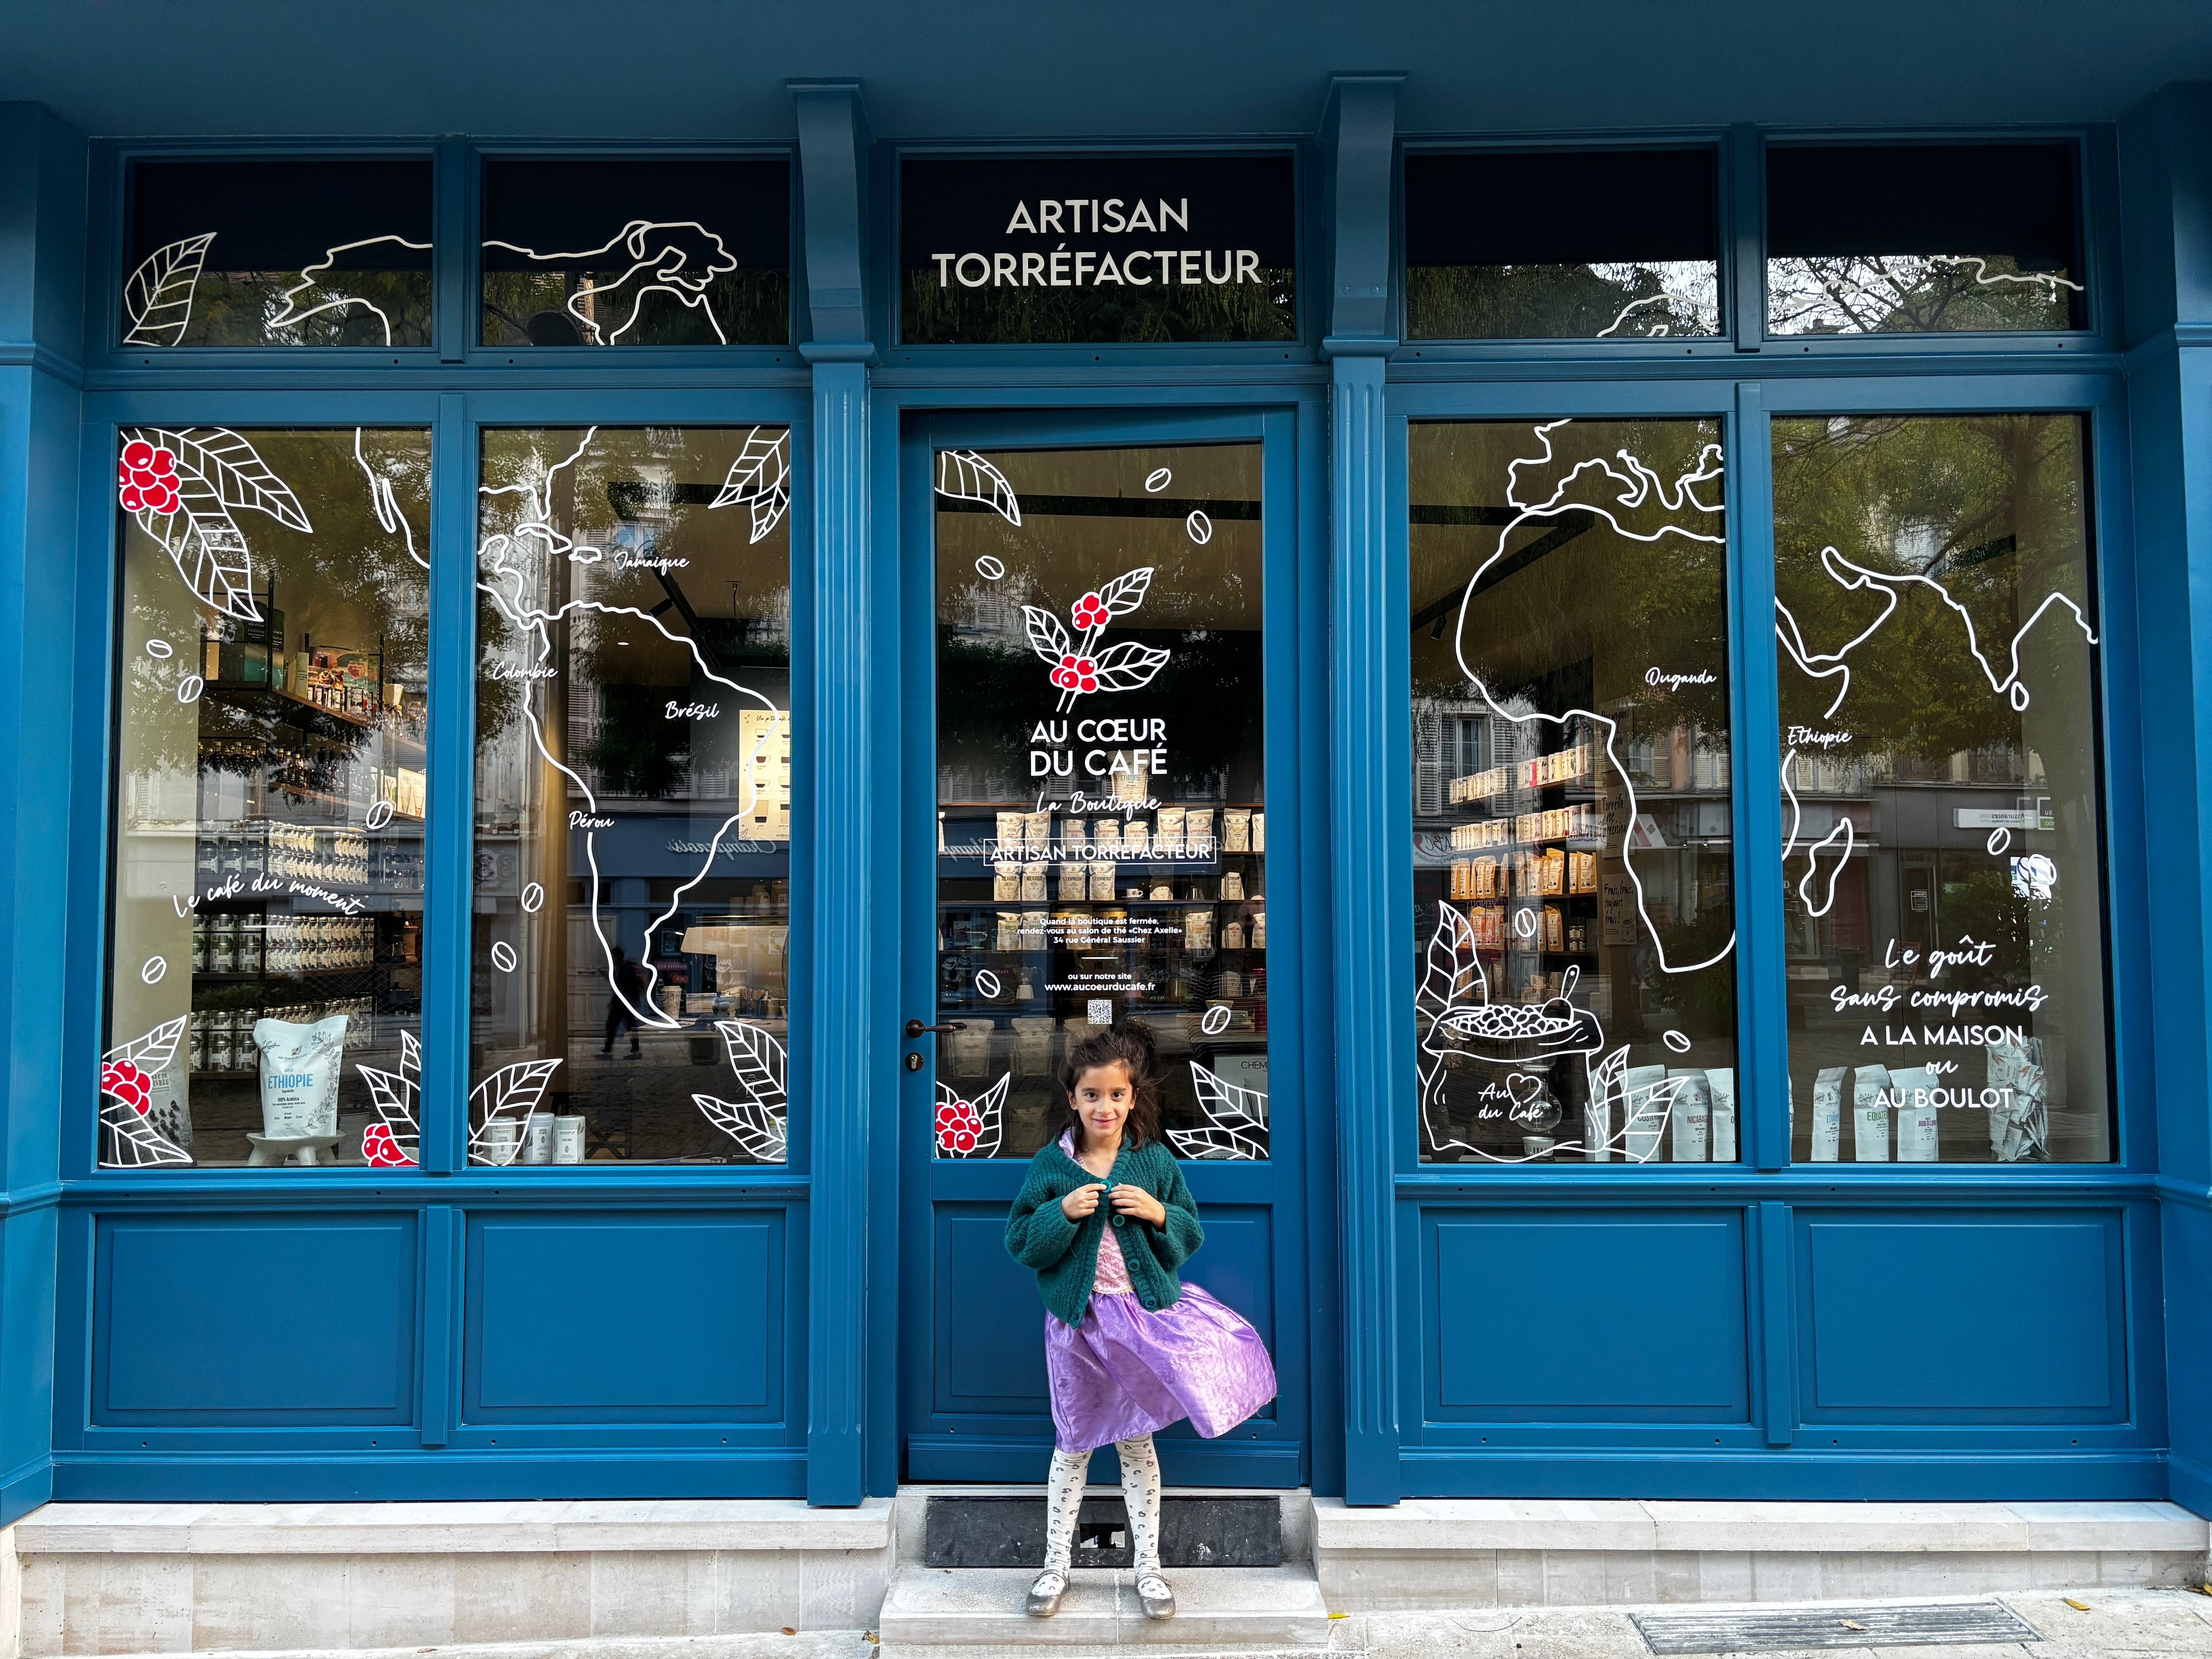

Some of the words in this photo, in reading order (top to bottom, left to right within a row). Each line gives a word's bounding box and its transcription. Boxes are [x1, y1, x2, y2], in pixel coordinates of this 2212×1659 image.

[1006, 198, 1188, 234] ARTISAN
[931, 243, 1262, 287] TORRÉFACTEUR
[493, 663, 558, 680] Colombie
[1646, 667, 1717, 692] Ouganda
[665, 701, 720, 721] Brésil
[1030, 720, 1067, 743] AU
[1077, 718, 1168, 742] CŒUR
[1787, 726, 1853, 749] Ethiopie
[1030, 749, 1073, 776] DU
[1084, 742, 1168, 776] CAFÉ
[1036, 791, 1062, 815] La
[1070, 790, 1162, 821] Boutique
[569, 810, 615, 830] Pérou
[990, 845, 1066, 861] ARTISAN
[173, 893, 200, 918] Le
[207, 873, 245, 902] café
[251, 872, 283, 892] du
[289, 879, 366, 916] moment
[1040, 918, 1066, 926] Quand
[1077, 918, 1114, 926] boutique
[1129, 918, 1159, 926] fermée,
[1885, 939, 1920, 970] Le
[1929, 934, 1996, 979] goût
[1044, 982, 1155, 991] www.aucoeurducafe.fr
[1910, 985, 2049, 1018] compromis
[1860, 1026, 1878, 1045] A
[1886, 1026, 1916, 1045] LA
[1924, 1025, 2023, 1045] MAISON
[1926, 1060, 1958, 1076] ou
[268, 1074, 313, 1089] ETHIOPIE
[1478, 1082, 1511, 1102] Au
[1873, 1088, 1906, 1108] AU
[1915, 1088, 2013, 1108] BOULOT
[1478, 1105, 1503, 1119] du
[1509, 1102, 1544, 1122] Café
